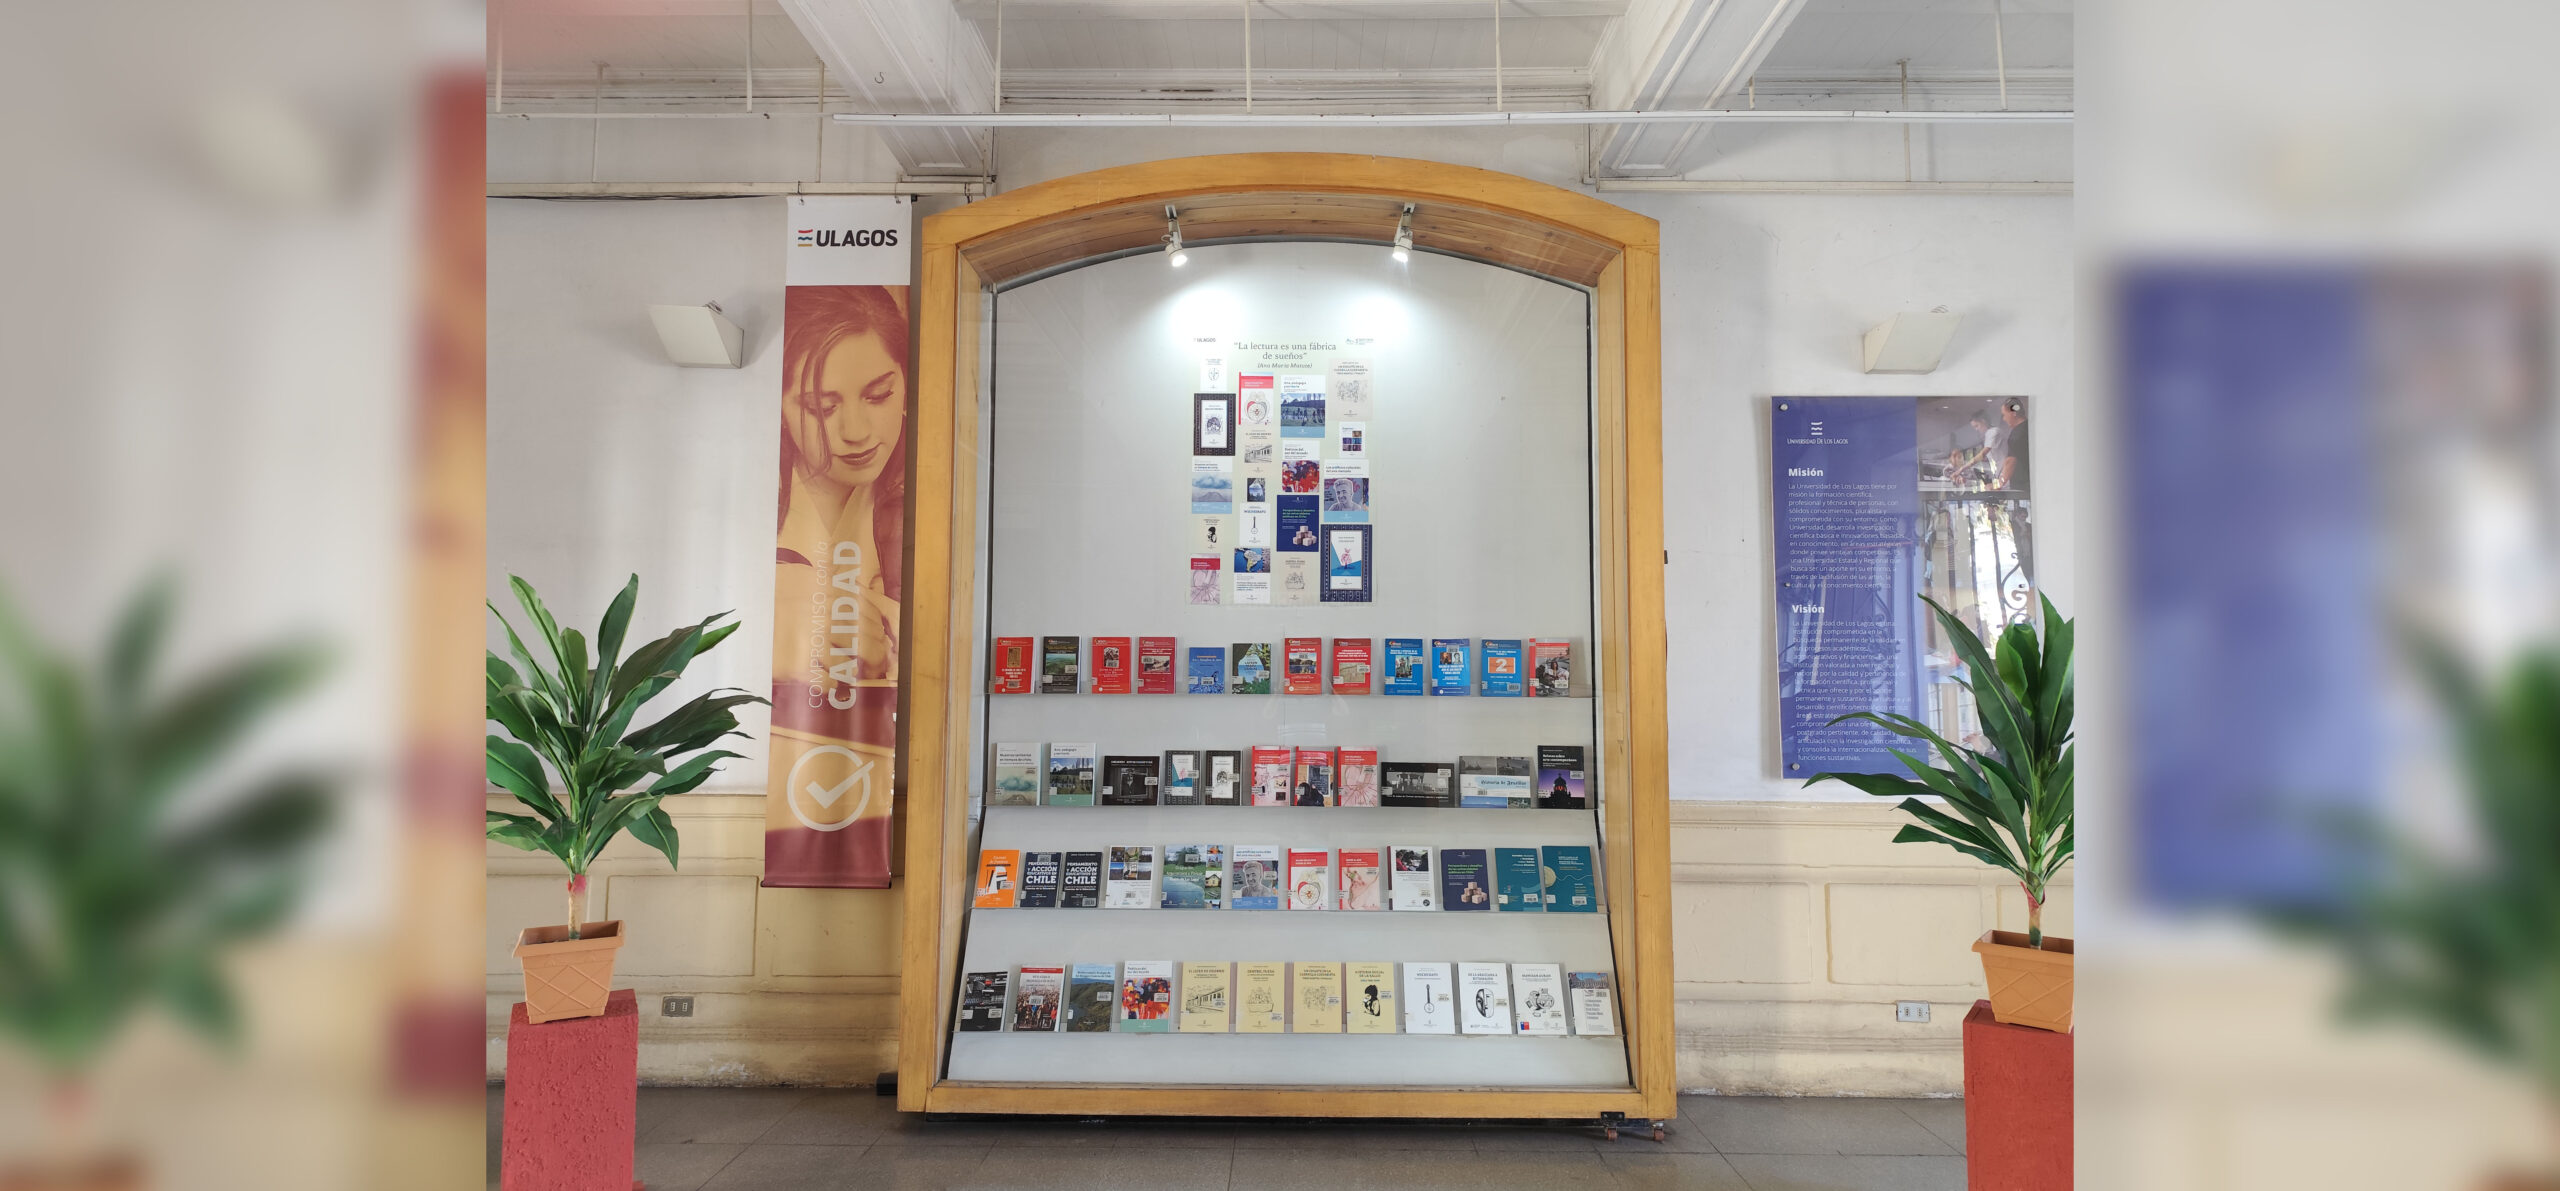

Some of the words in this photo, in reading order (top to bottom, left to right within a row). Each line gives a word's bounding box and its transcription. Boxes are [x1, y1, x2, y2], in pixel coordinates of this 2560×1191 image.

[816, 229, 898, 247] ULAGOS
[1250, 342, 1278, 350] lectura
[1309, 342, 1337, 350] fábrica
[1262, 352, 1272, 360] de
[1788, 468, 1824, 476] Misión
[1853, 483, 1870, 491] Lagos
[817, 559, 827, 588] con
[1792, 604, 1824, 613] Visión
[828, 540, 861, 710] CALIDAD
[808, 590, 827, 709] COMPROMISO
[1495, 659, 1507, 672] 2
[1026, 876, 1056, 884] CHILE
[1065, 876, 1096, 884] CHILE
